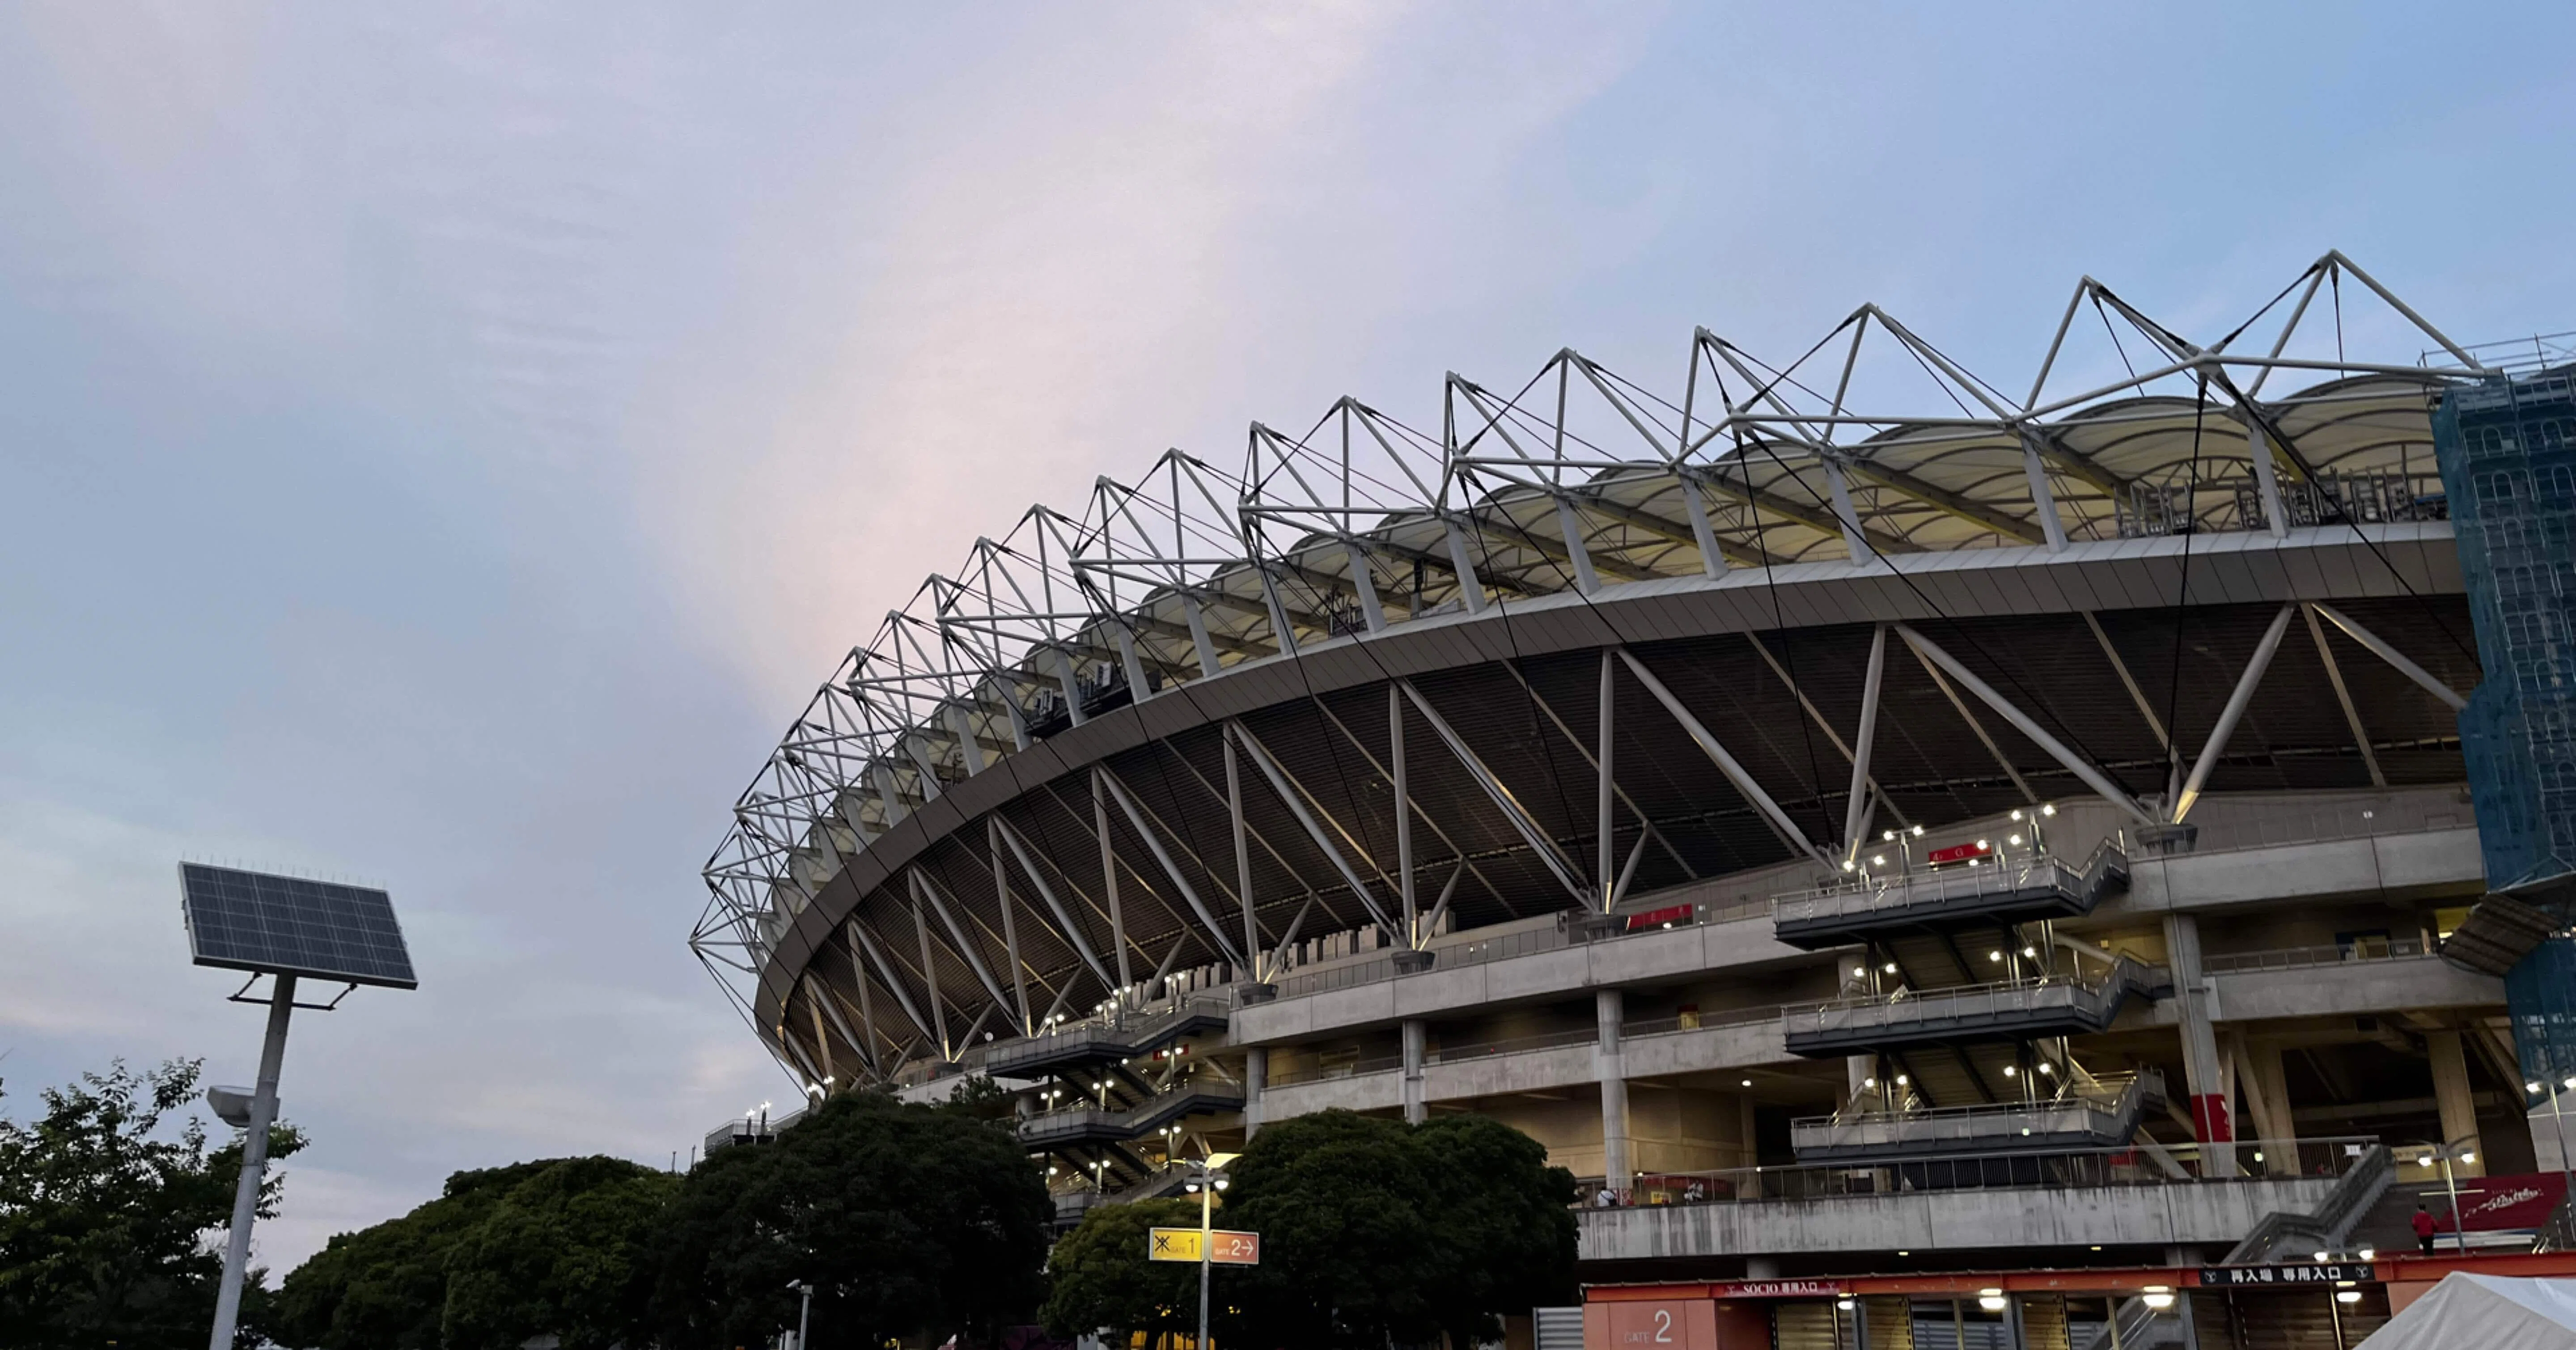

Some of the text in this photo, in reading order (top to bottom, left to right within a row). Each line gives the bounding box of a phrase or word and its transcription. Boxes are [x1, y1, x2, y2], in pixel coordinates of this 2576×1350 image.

[1189, 1238, 1195, 1254] 1
[1231, 1239, 1241, 1256] 2
[1624, 1309, 1672, 1343] GATE 2
